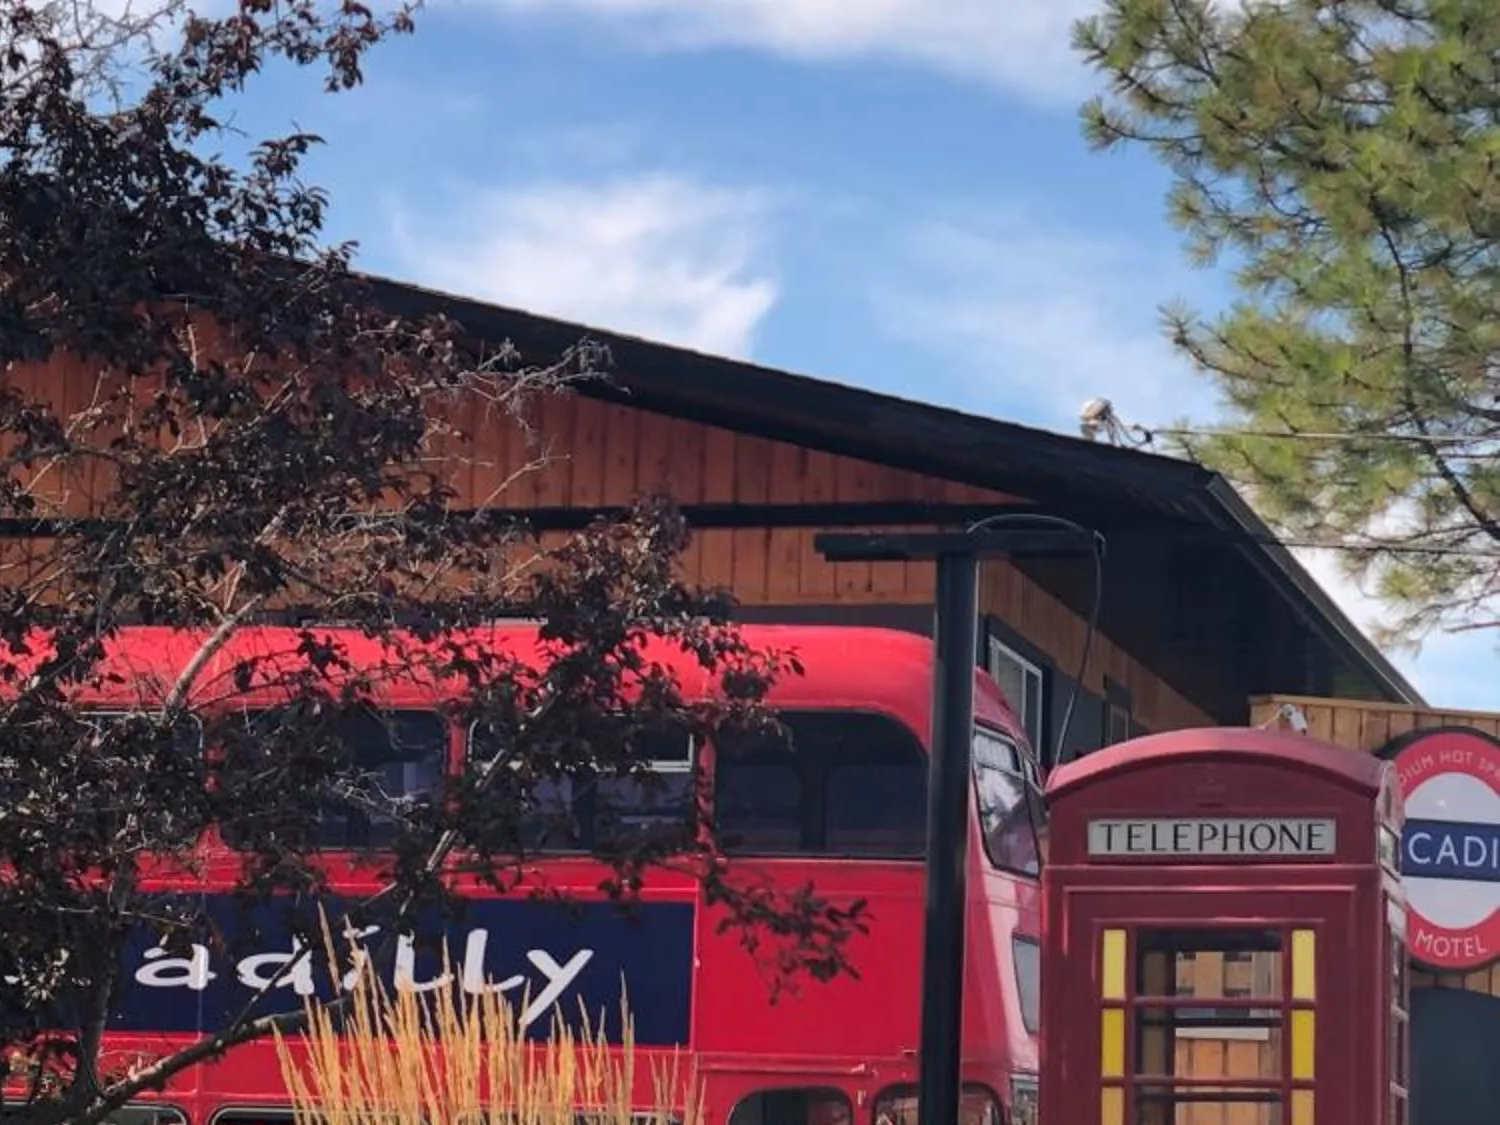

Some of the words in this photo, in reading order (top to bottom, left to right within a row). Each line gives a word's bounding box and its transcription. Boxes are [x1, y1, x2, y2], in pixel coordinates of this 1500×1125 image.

[1440, 749, 1473, 766] HOT
[1099, 822, 1325, 852] TELEPHONE
[1408, 832, 1499, 869] CADI
[1414, 928, 1488, 957] MOTEL
